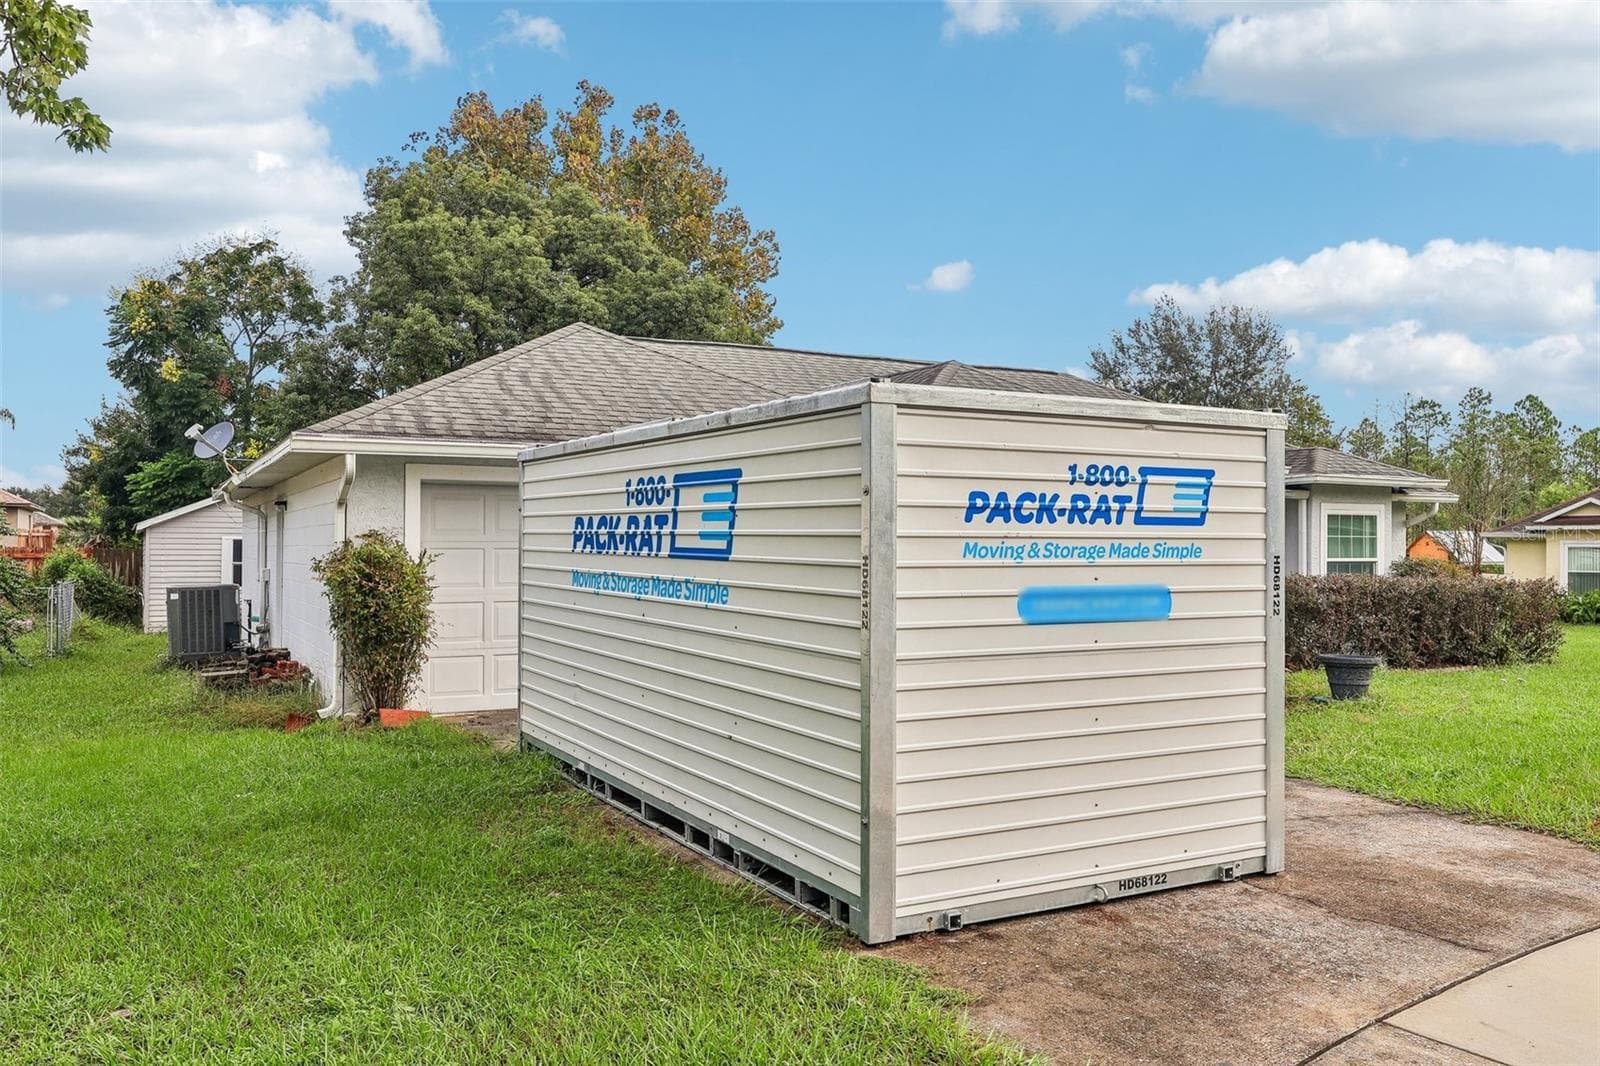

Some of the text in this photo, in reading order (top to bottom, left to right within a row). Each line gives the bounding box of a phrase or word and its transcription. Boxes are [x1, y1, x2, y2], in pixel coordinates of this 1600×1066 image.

[964, 490, 1133, 525] PACK-RAT
[572, 514, 669, 557] PACK-RAT
[962, 541, 1202, 563] Moving & Storage Made Simple
[571, 569, 729, 608] Moving & Storage Made Simple
[1272, 555, 1281, 616] HD68122
[1118, 873, 1168, 891] HD68122
